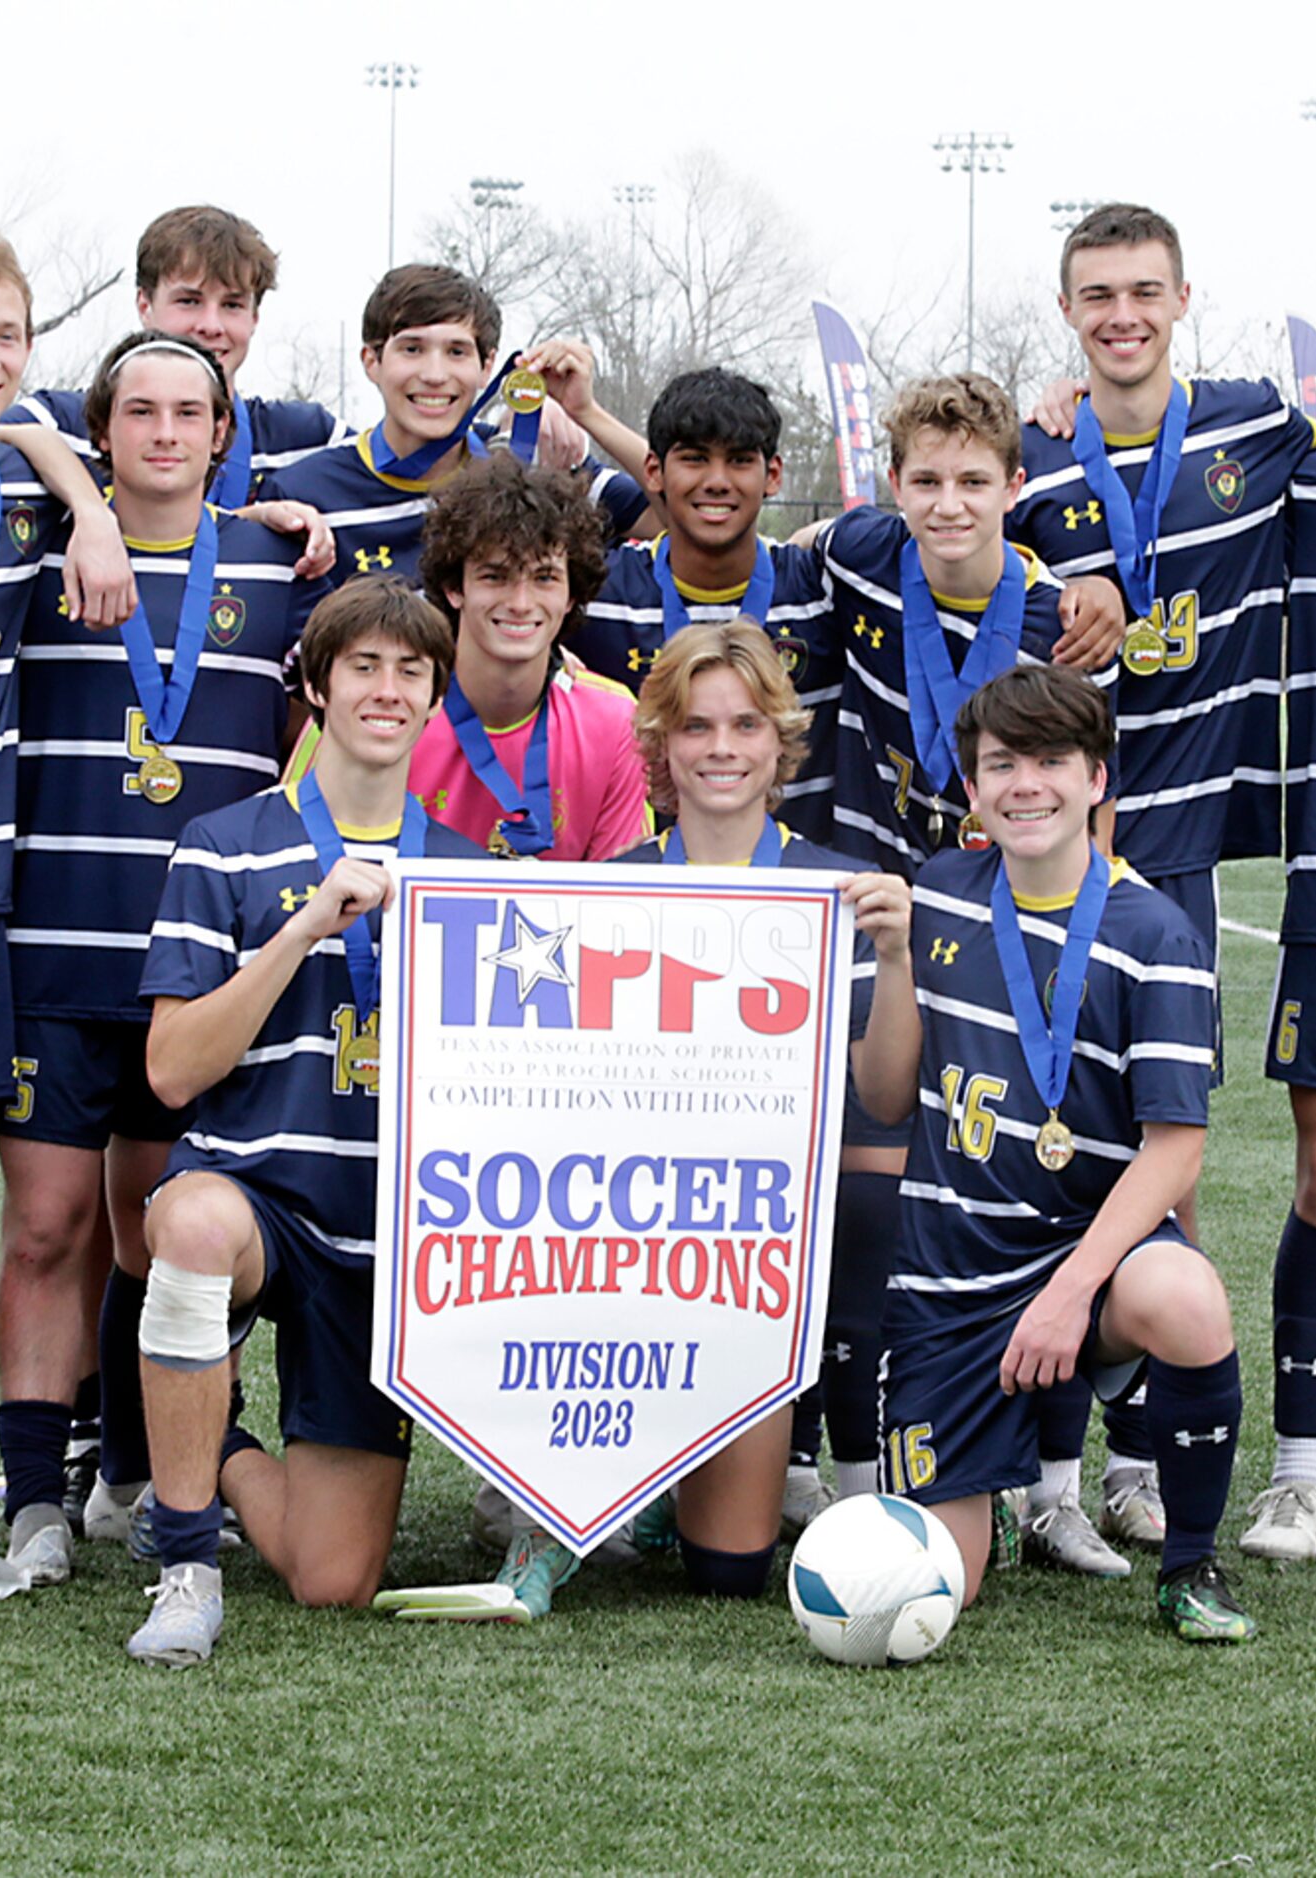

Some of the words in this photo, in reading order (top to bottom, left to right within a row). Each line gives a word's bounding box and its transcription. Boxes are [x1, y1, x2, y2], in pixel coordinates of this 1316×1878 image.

[885, 743, 914, 819] 7
[422, 895, 813, 1036] TAPPS
[438, 1036, 511, 1053] TEXAS
[517, 1039, 667, 1059] ASSOCIATION
[675, 1043, 702, 1059] OF
[710, 1044, 801, 1062] PRIVATE
[1275, 999, 1302, 1065] 6
[4, 1056, 39, 1123] 5
[428, 1084, 614, 1111] COMPETITION
[622, 1088, 699, 1113] WITH
[700, 1091, 798, 1116] HONOR
[464, 1060, 515, 1076] AND
[525, 1062, 662, 1081] PAROCHIAL
[669, 1065, 775, 1084] SCHOOLS
[940, 1063, 1008, 1164] 16
[416, 1150, 796, 1234] SOCCER
[413, 1232, 793, 1321] CHAMPIONS
[498, 1340, 675, 1391] DIVISION
[680, 1341, 700, 1391] I
[549, 1399, 635, 1449] 2023
[887, 1421, 937, 1495] 16
